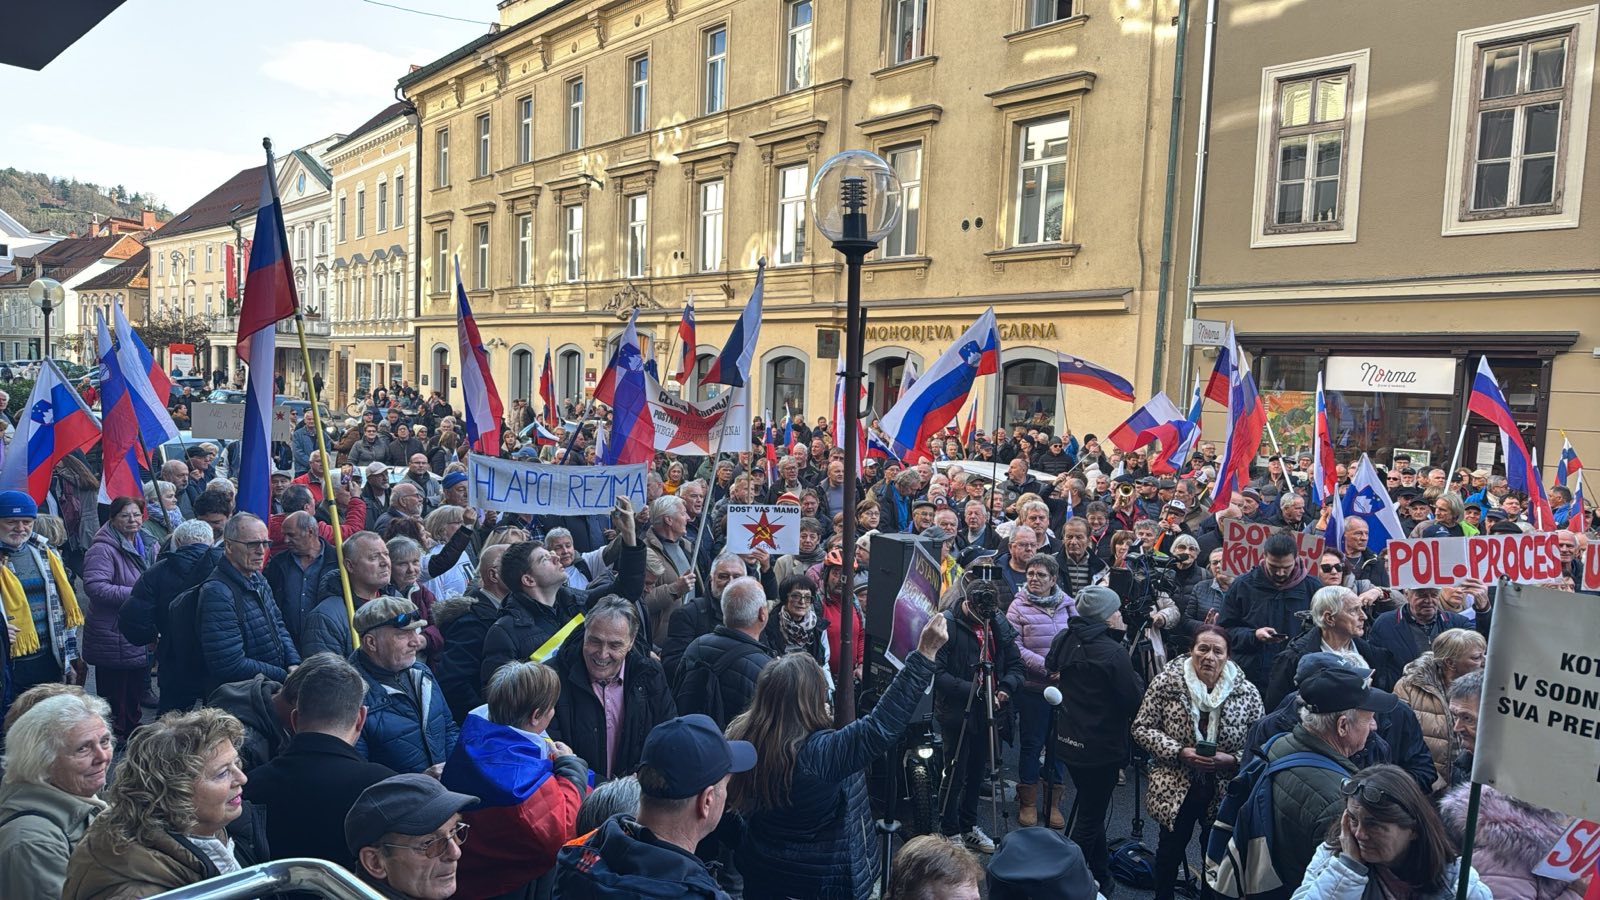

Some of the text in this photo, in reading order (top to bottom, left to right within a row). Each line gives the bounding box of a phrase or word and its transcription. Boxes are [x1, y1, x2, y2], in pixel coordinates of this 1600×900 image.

[865, 322, 1057, 343] MOHORJEVA KGARNA
[1361, 362, 1416, 386] Norma
[475, 463, 646, 509] HLAPCI REŽIMA
[1513, 672, 1600, 711] V SODN
[1497, 696, 1539, 723] SVA
